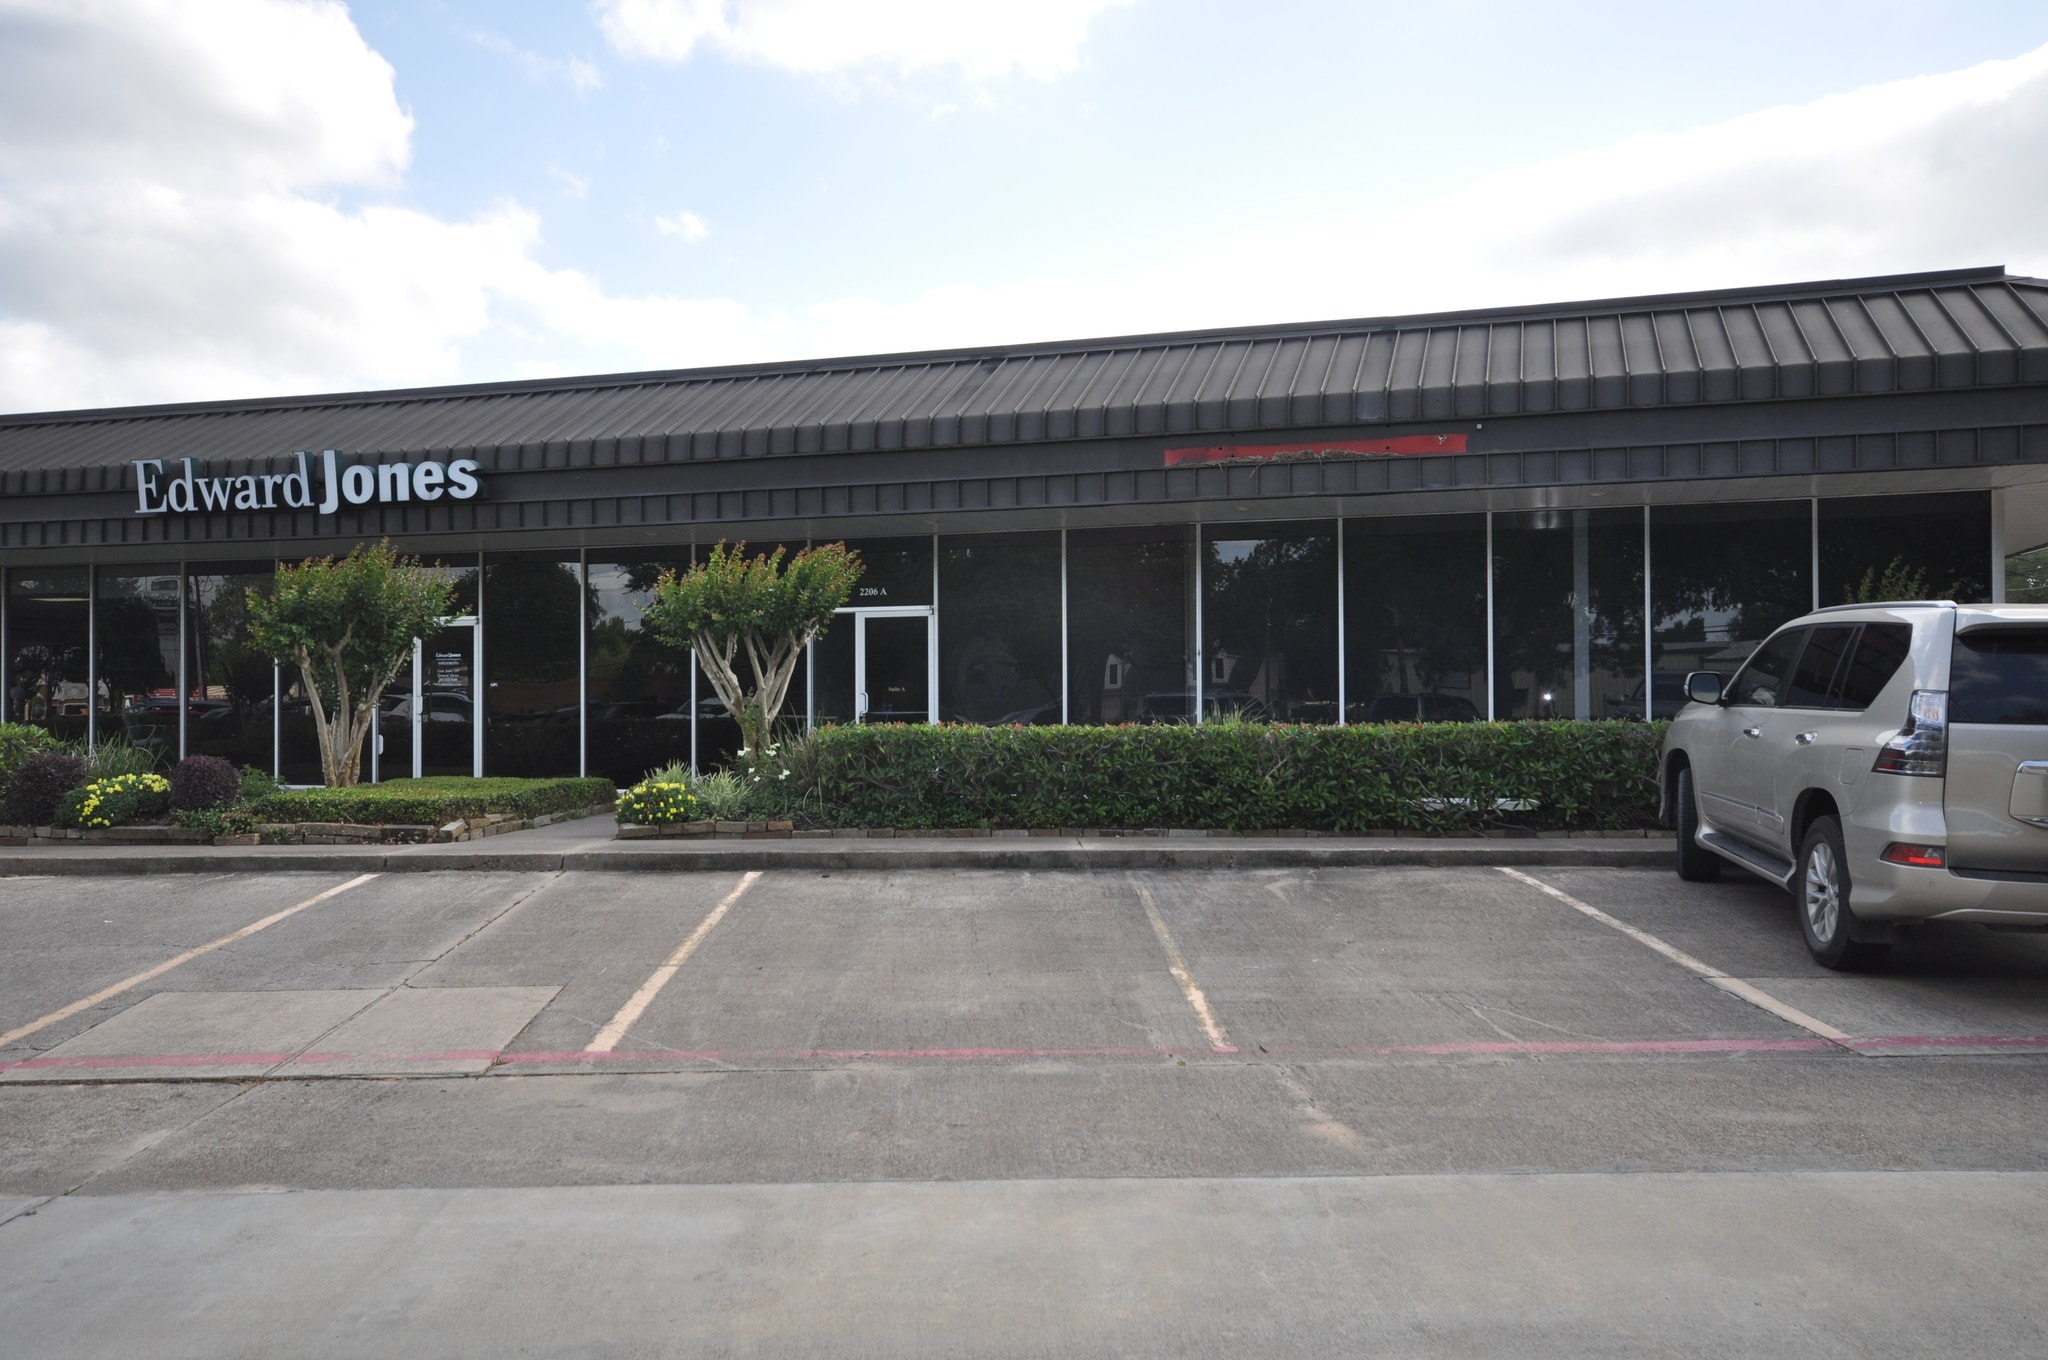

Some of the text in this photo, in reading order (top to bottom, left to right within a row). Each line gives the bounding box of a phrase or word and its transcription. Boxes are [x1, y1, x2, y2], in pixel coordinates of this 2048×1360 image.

[130, 449, 481, 515] Edward Jones
[859, 587, 888, 596] 2206 A
